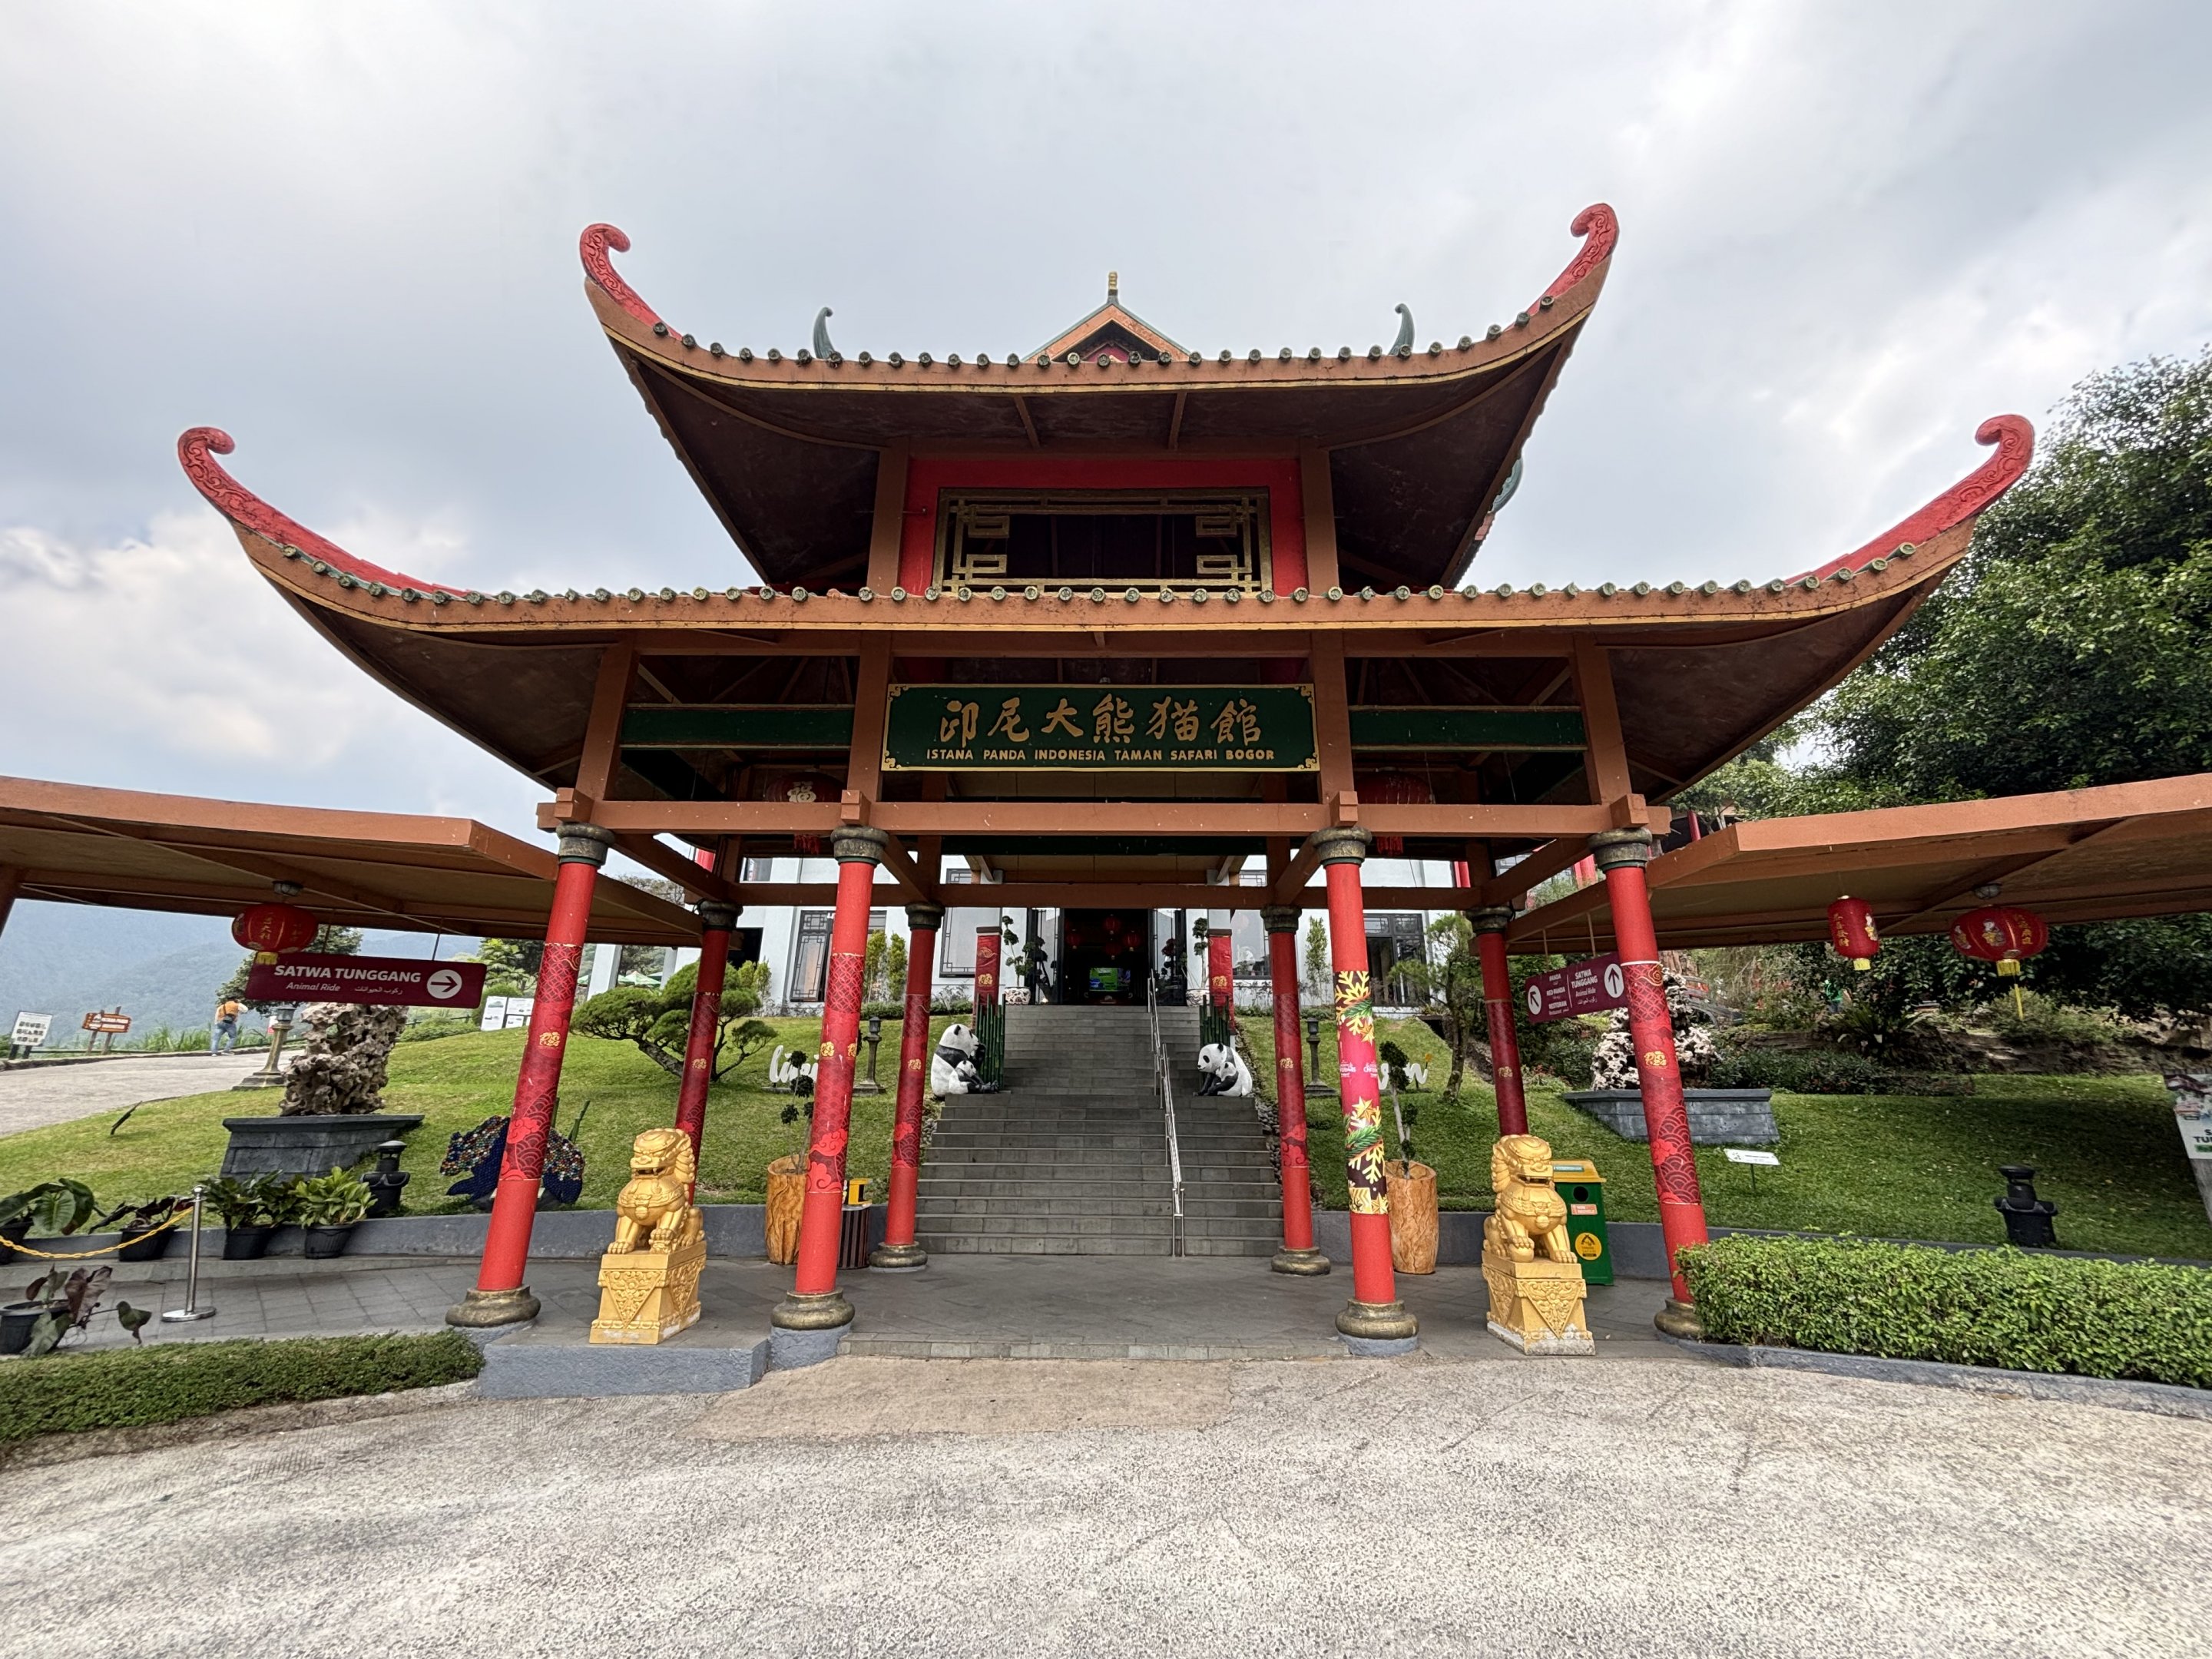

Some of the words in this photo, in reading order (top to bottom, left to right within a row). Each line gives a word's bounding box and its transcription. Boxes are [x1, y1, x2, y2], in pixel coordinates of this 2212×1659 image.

[926, 750, 974, 760] ISTANA
[983, 750, 1026, 760] PANDA
[1034, 750, 1106, 761] INDONESIA
[1114, 750, 1163, 761] TAMAN
[1170, 750, 1218, 761] SAFARI
[1226, 750, 1275, 760] BOGOR
[274, 965, 331, 978] SATWA
[335, 968, 421, 983] TUNGGANG
[1575, 969, 1591, 979] SATWA
[286, 982, 319, 992] Animal
[320, 983, 340, 992] Ride
[1571, 975, 1598, 988] TUNGGANG
